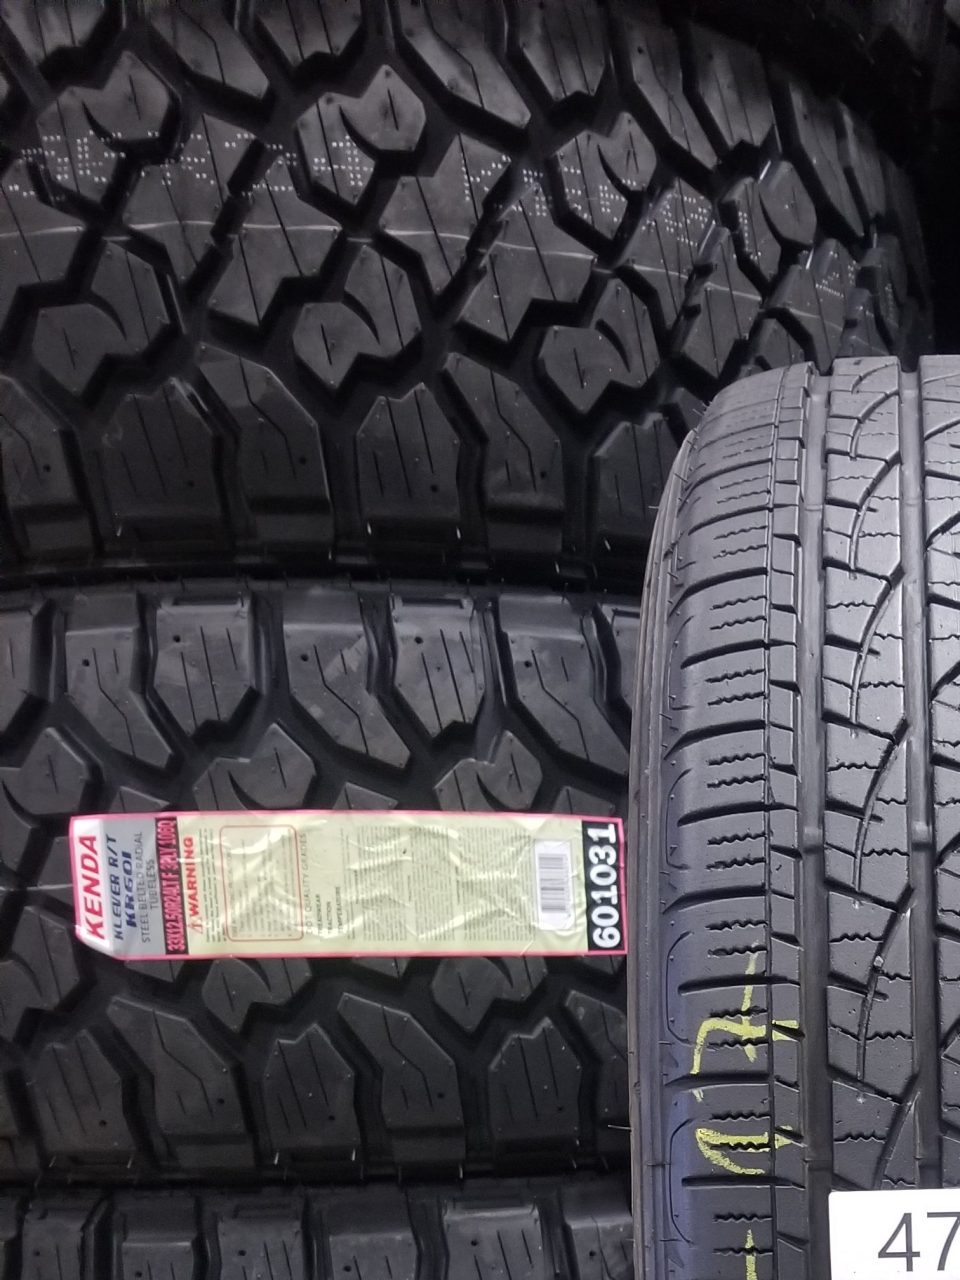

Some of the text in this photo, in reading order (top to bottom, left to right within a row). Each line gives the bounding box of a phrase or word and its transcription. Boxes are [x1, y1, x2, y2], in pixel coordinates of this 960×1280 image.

[79, 834, 106, 941] KENDA
[105, 833, 124, 941] KLEVER R/T
[121, 850, 138, 929] KR601
[134, 831, 151, 944] STEEL BELTED RADIAL
[146, 858, 159, 910] TUBELESS
[183, 836, 200, 918] WARNING
[299, 832, 309, 871] GRADES
[302, 872, 313, 913] QUALITY
[586, 823, 621, 949] 601031
